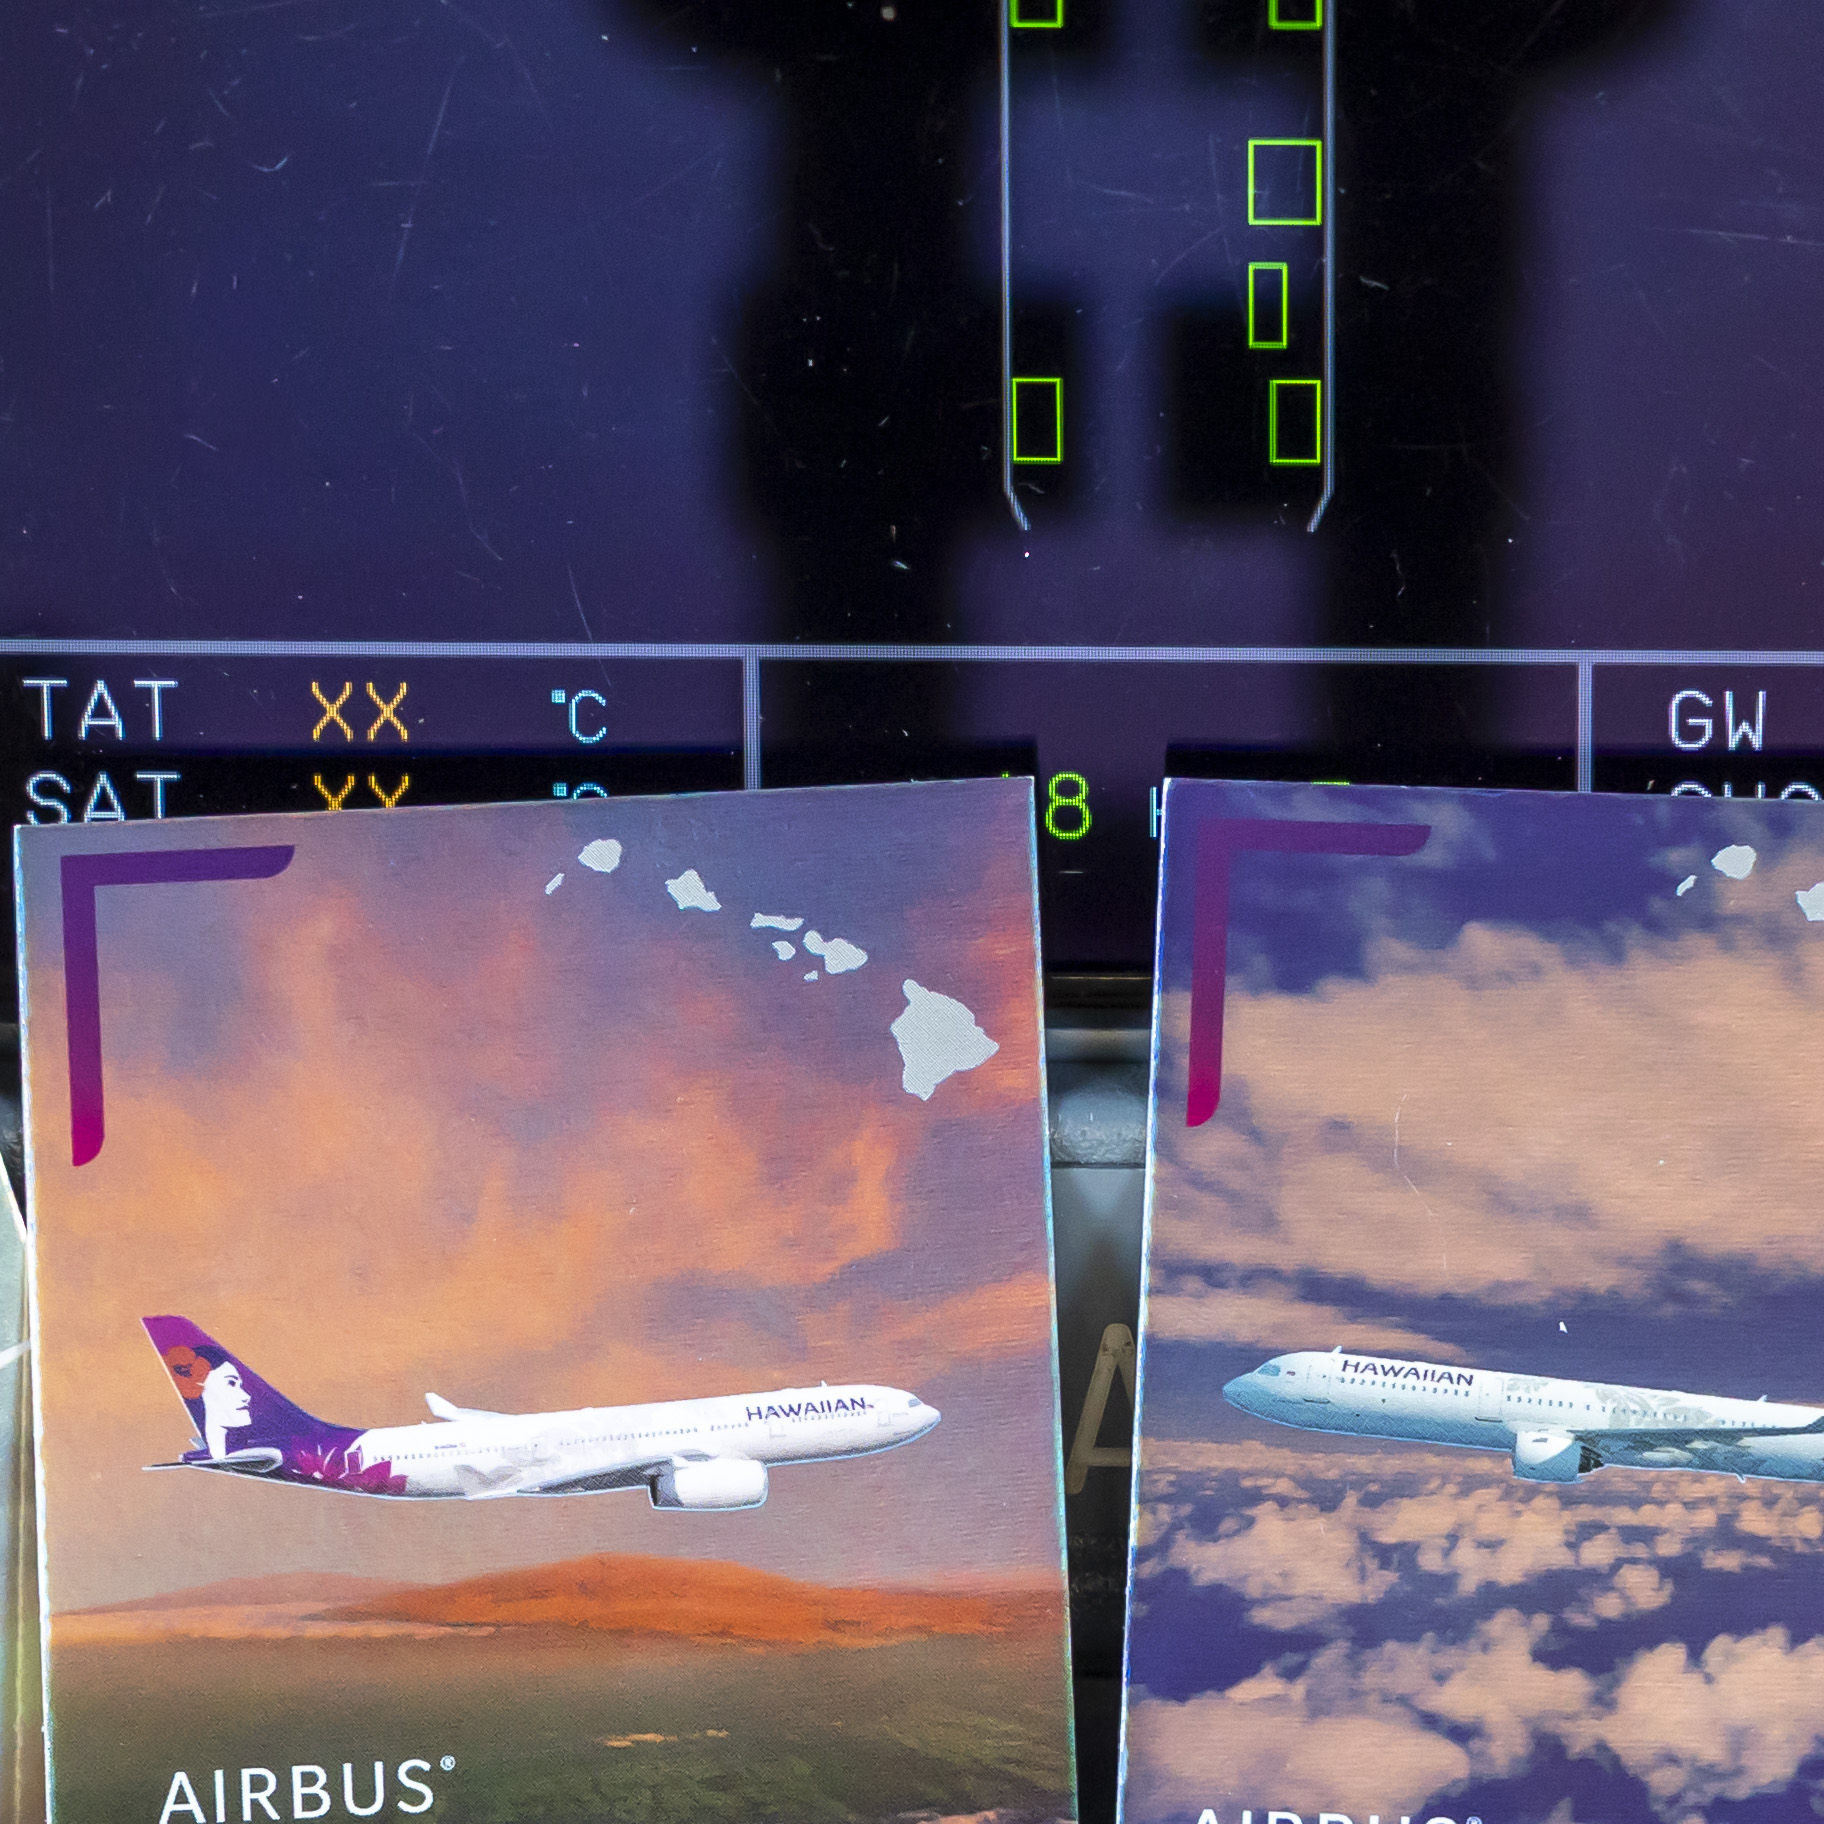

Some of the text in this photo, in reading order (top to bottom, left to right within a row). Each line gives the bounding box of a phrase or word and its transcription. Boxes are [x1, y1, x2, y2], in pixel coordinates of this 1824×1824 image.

[23, 679, 179, 740] TAT
[311, 680, 409, 742] XX
[1668, 689, 1767, 752] GW
[24, 771, 181, 824] SAT
[1341, 1359, 1474, 1386] HAWAIIAN
[747, 1397, 866, 1422] HAWAIIAN
